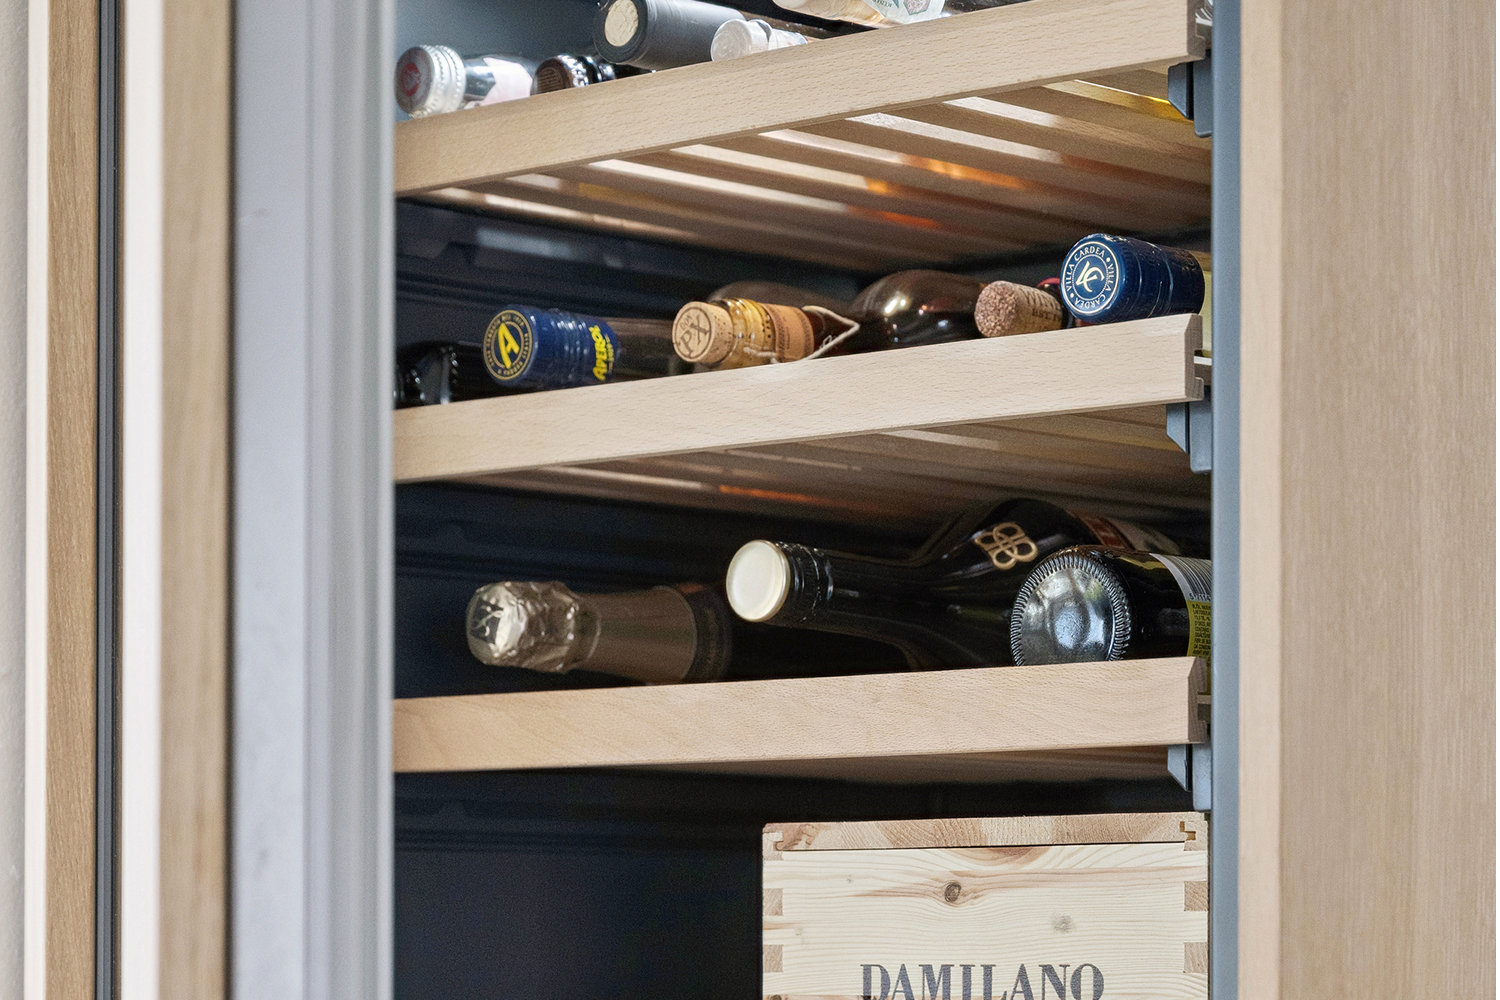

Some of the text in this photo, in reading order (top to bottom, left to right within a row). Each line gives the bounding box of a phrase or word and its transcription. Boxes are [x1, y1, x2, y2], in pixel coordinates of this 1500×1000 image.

[1065, 245, 1105, 292] VILLA CARDEA
[1075, 263, 1115, 309] VILLA CARDEA
[588, 324, 608, 380] APEROL
[680, 314, 710, 356] PX
